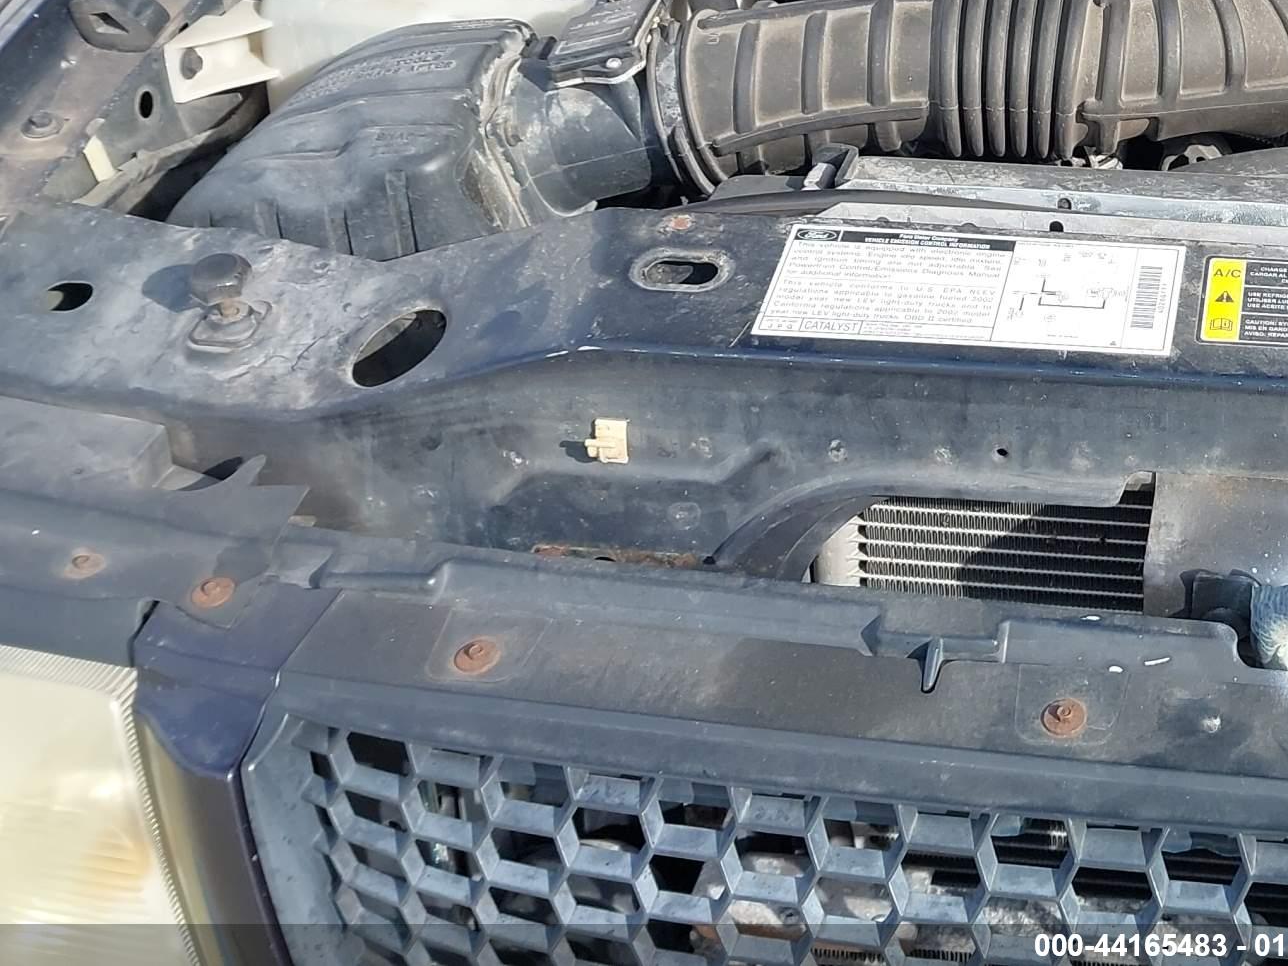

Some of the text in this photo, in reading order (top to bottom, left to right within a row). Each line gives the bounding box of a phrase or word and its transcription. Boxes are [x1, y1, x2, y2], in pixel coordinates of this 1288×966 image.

[804, 228, 829, 237] Ford
[948, 241, 990, 249] INFORMATION
[1213, 268, 1241, 278] A/C
[803, 319, 859, 333] CATALYST
